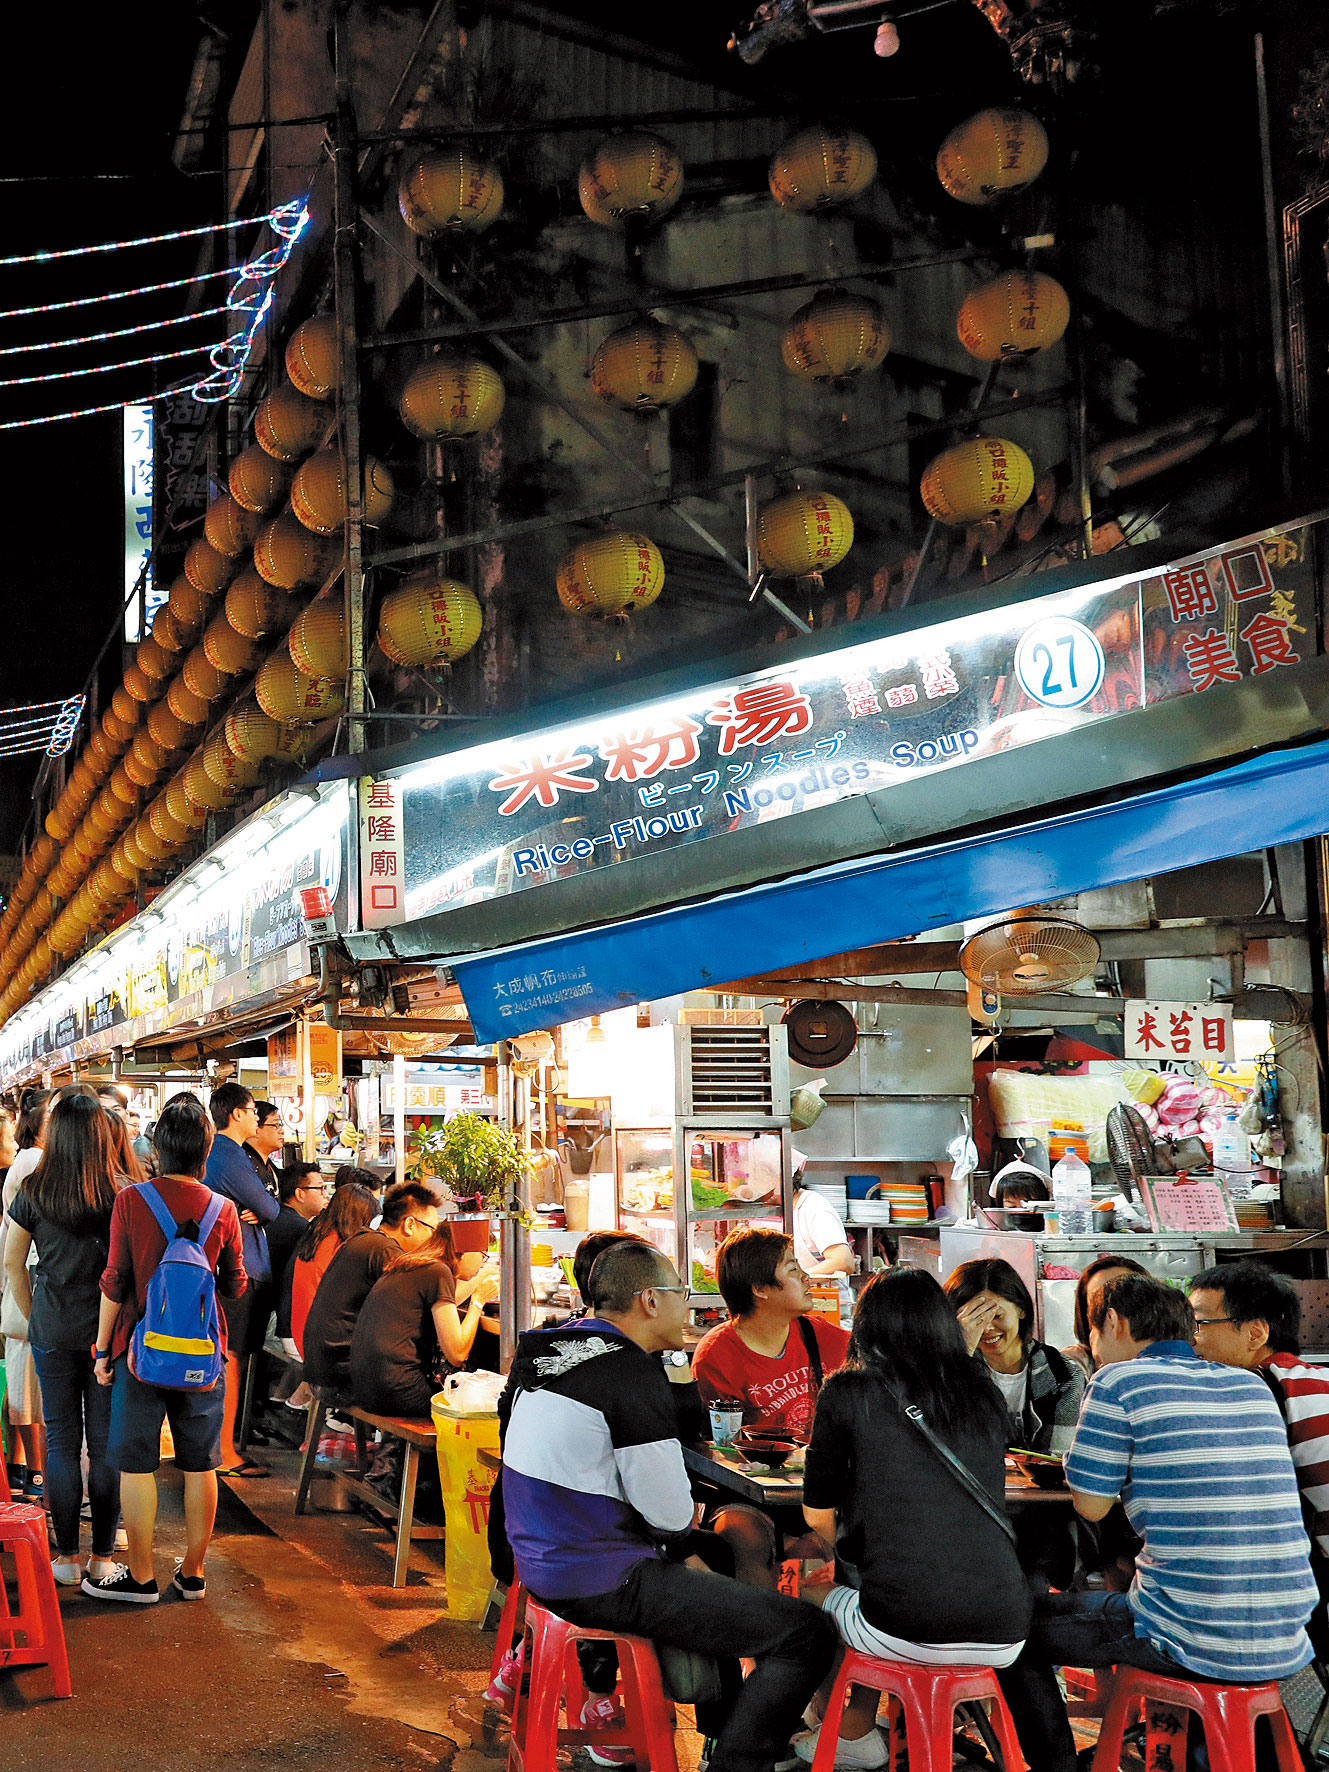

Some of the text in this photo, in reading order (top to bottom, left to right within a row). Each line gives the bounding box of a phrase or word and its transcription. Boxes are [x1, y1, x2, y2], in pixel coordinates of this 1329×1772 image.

[1162, 542, 1274, 623] 廟口
[1032, 634, 1080, 697] 27
[1183, 612, 1301, 692] 美食
[489, 682, 814, 816] 米粉湯
[639, 731, 847, 808] ビーフンスープ
[512, 801, 703, 878] Rice-Flour
[724, 757, 870, 820] Noodles
[890, 728, 980, 769] Soup
[366, 782, 399, 910] 基隆廟口
[492, 968, 557, 999] 大成帆布
[1134, 1010, 1226, 1054] 米苔目
